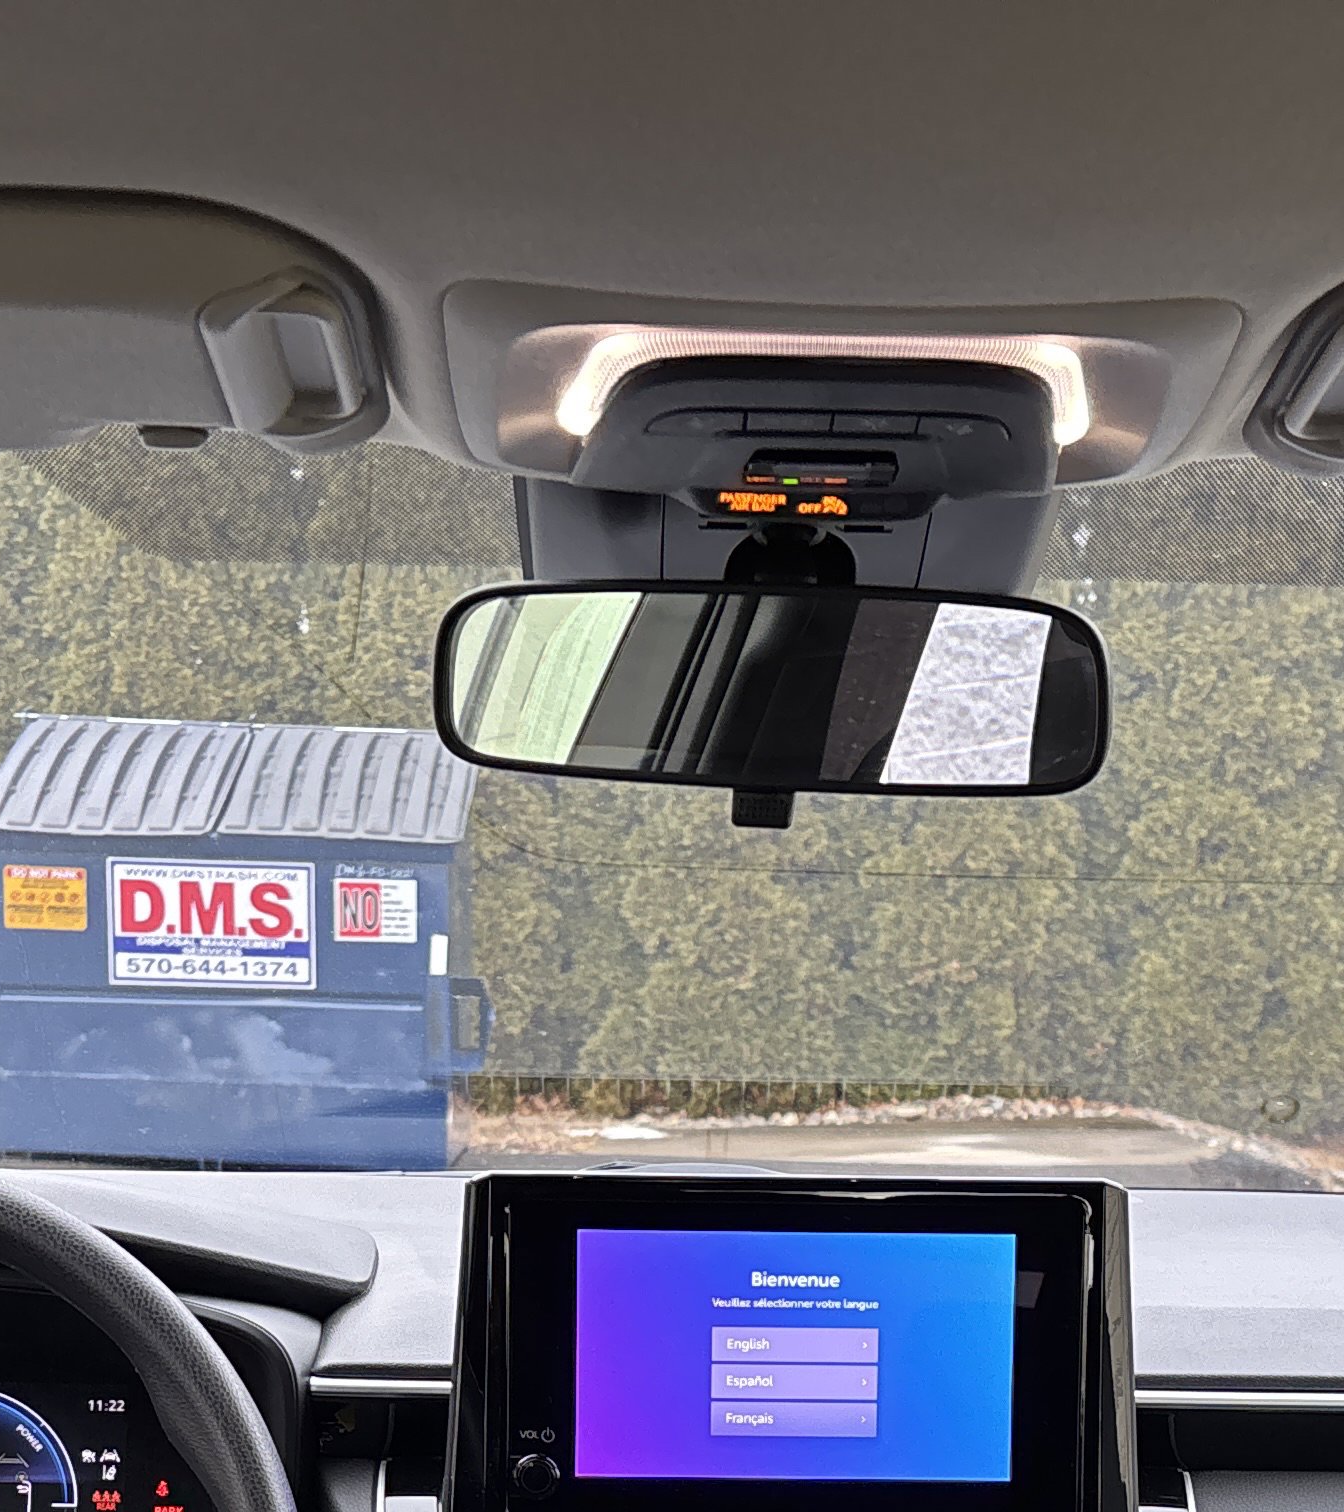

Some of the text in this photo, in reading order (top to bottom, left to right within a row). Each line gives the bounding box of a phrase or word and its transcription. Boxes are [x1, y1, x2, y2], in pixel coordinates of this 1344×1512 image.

[719, 492, 787, 505] PASSENGER
[798, 503, 821, 514] OFF
[119, 878, 303, 938] D.M.S.
[342, 889, 378, 930] NO
[126, 957, 299, 977] 570-644-1374
[751, 1270, 841, 1288] Bienvenue
[711, 1297, 879, 1312] Veuillez sélectionner votre langue
[726, 1338, 770, 1352] English
[726, 1375, 774, 1388] Español
[87, 1400, 125, 1412] 11:22
[725, 1413, 775, 1426] Français
[16, 1424, 44, 1452] POWER
[519, 1430, 539, 1439] VOL
[96, 1503, 116, 1511] REAR
